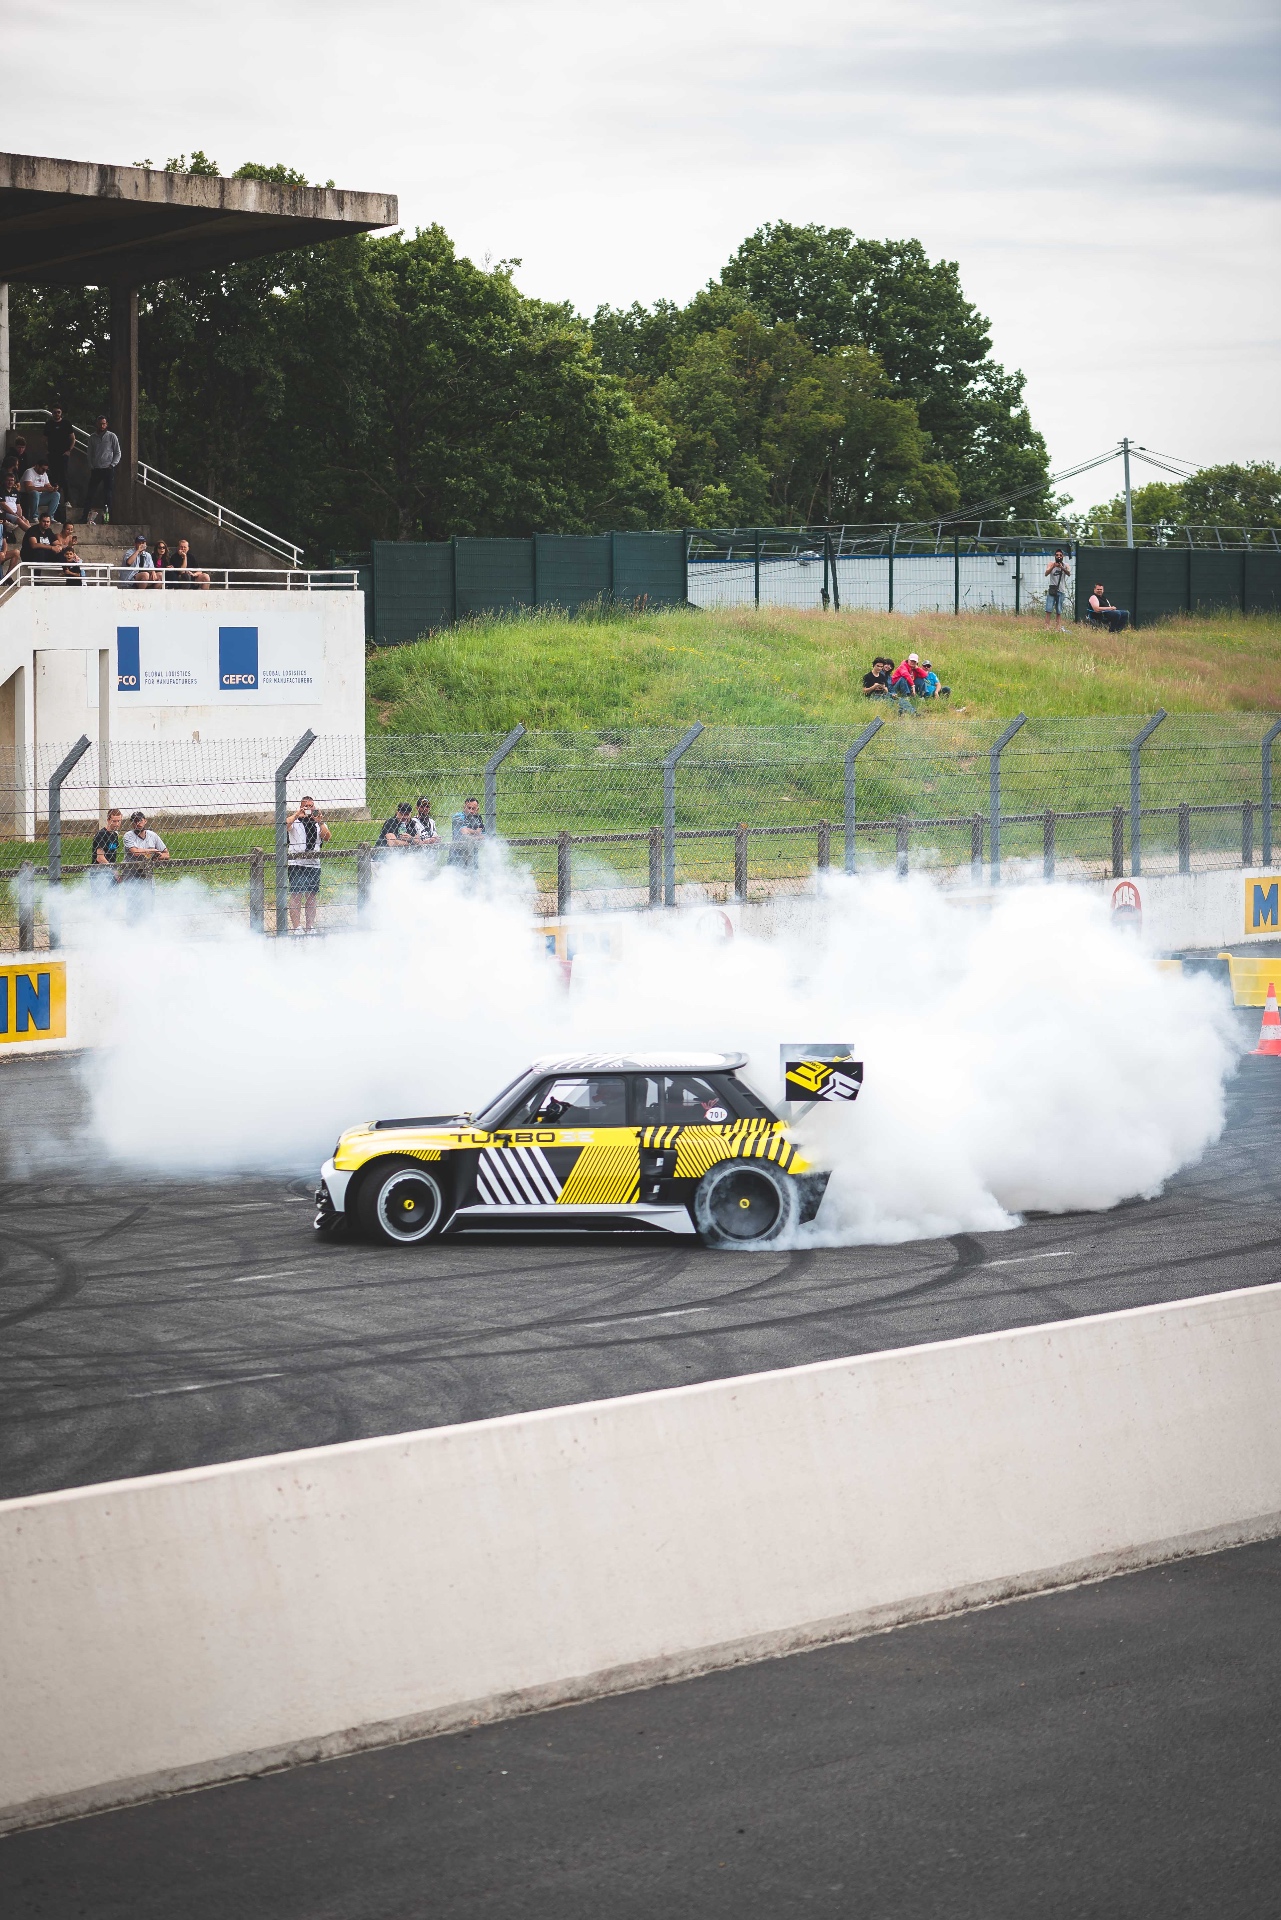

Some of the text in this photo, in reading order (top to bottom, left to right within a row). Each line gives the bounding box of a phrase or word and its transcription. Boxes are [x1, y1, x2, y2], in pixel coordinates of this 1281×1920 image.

[144, 670, 164, 678] GLOBAL
[222, 674, 256, 685] GEFCO
[709, 1111, 723, 1119] 701
